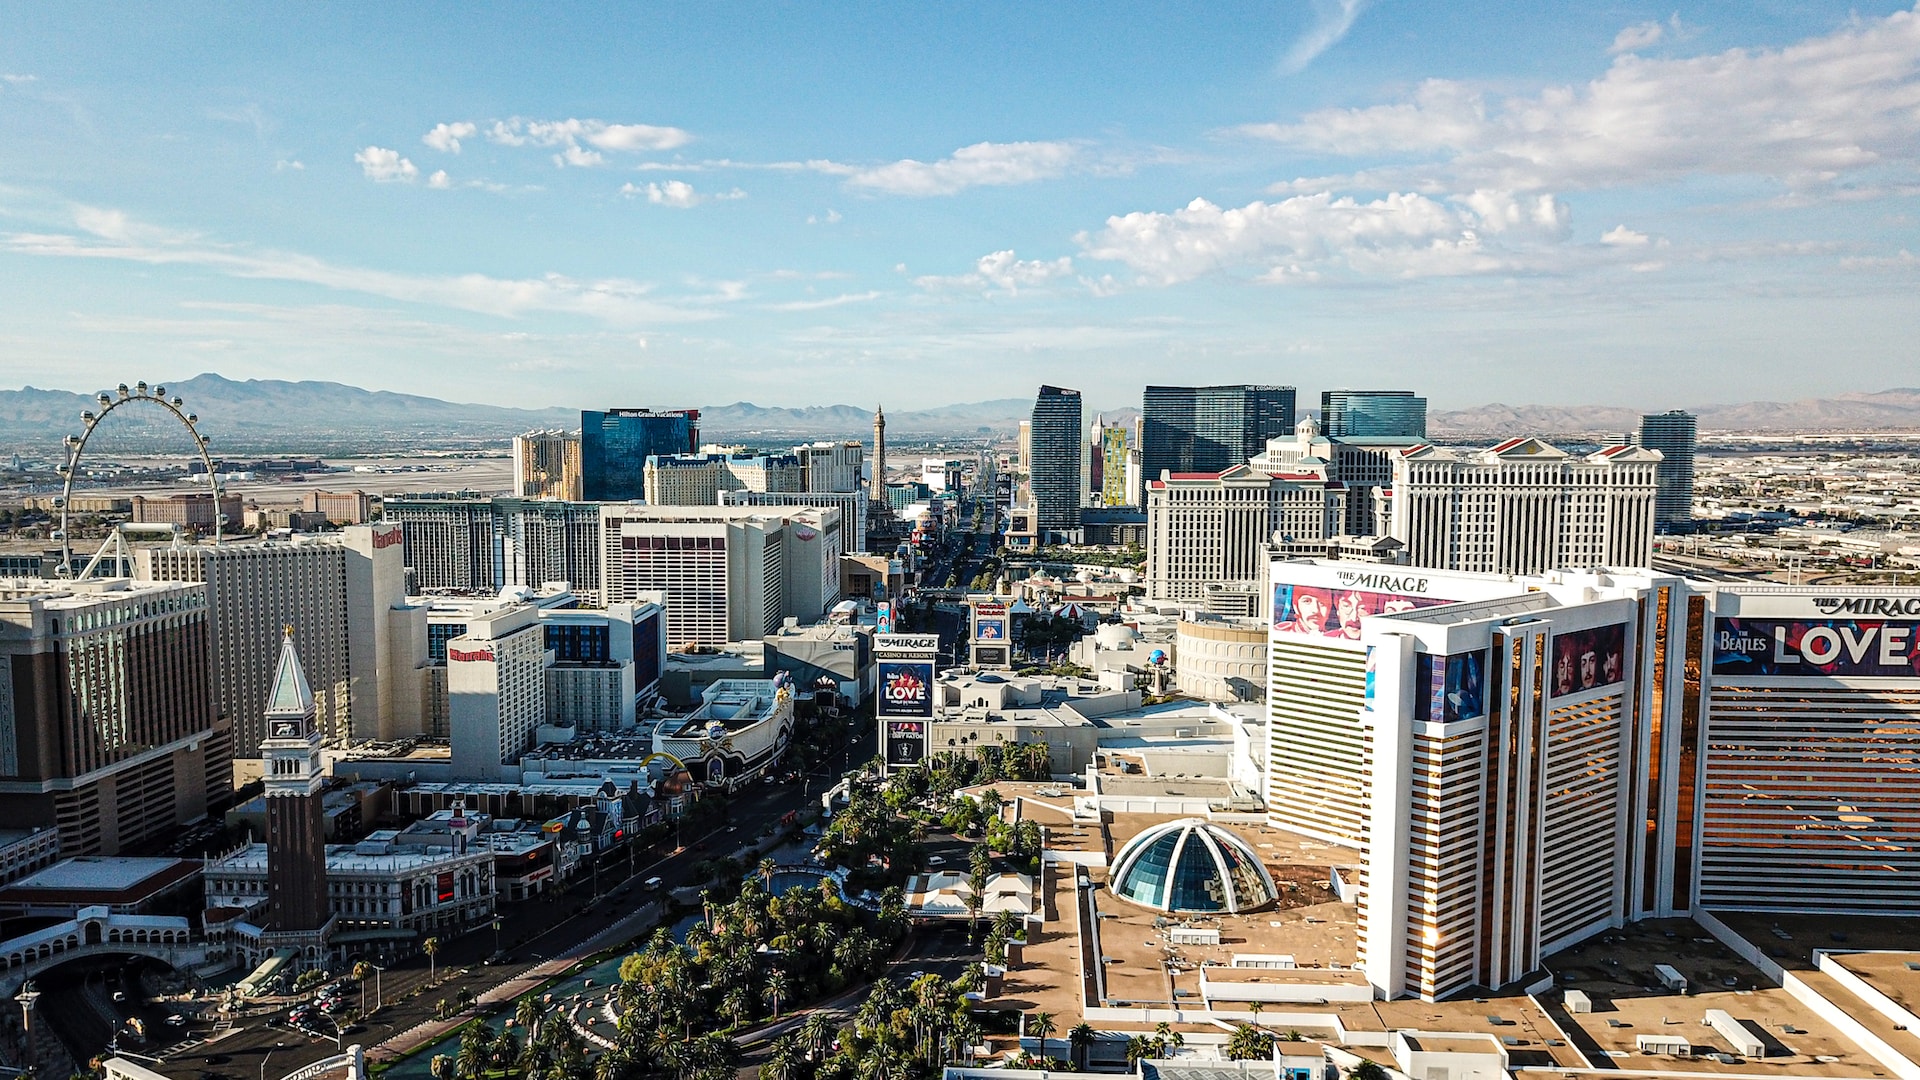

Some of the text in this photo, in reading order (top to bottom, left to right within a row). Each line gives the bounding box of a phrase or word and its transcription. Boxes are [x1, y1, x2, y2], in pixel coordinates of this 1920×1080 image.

[1337, 571, 1428, 592] THE MIRAGE
[1812, 598, 1841, 607] THE
[881, 639, 935, 648] MIRAGE
[1720, 631, 1767, 654] BEATLES
[1774, 625, 1911, 666] LOVE
[885, 686, 926, 700] LOVE
